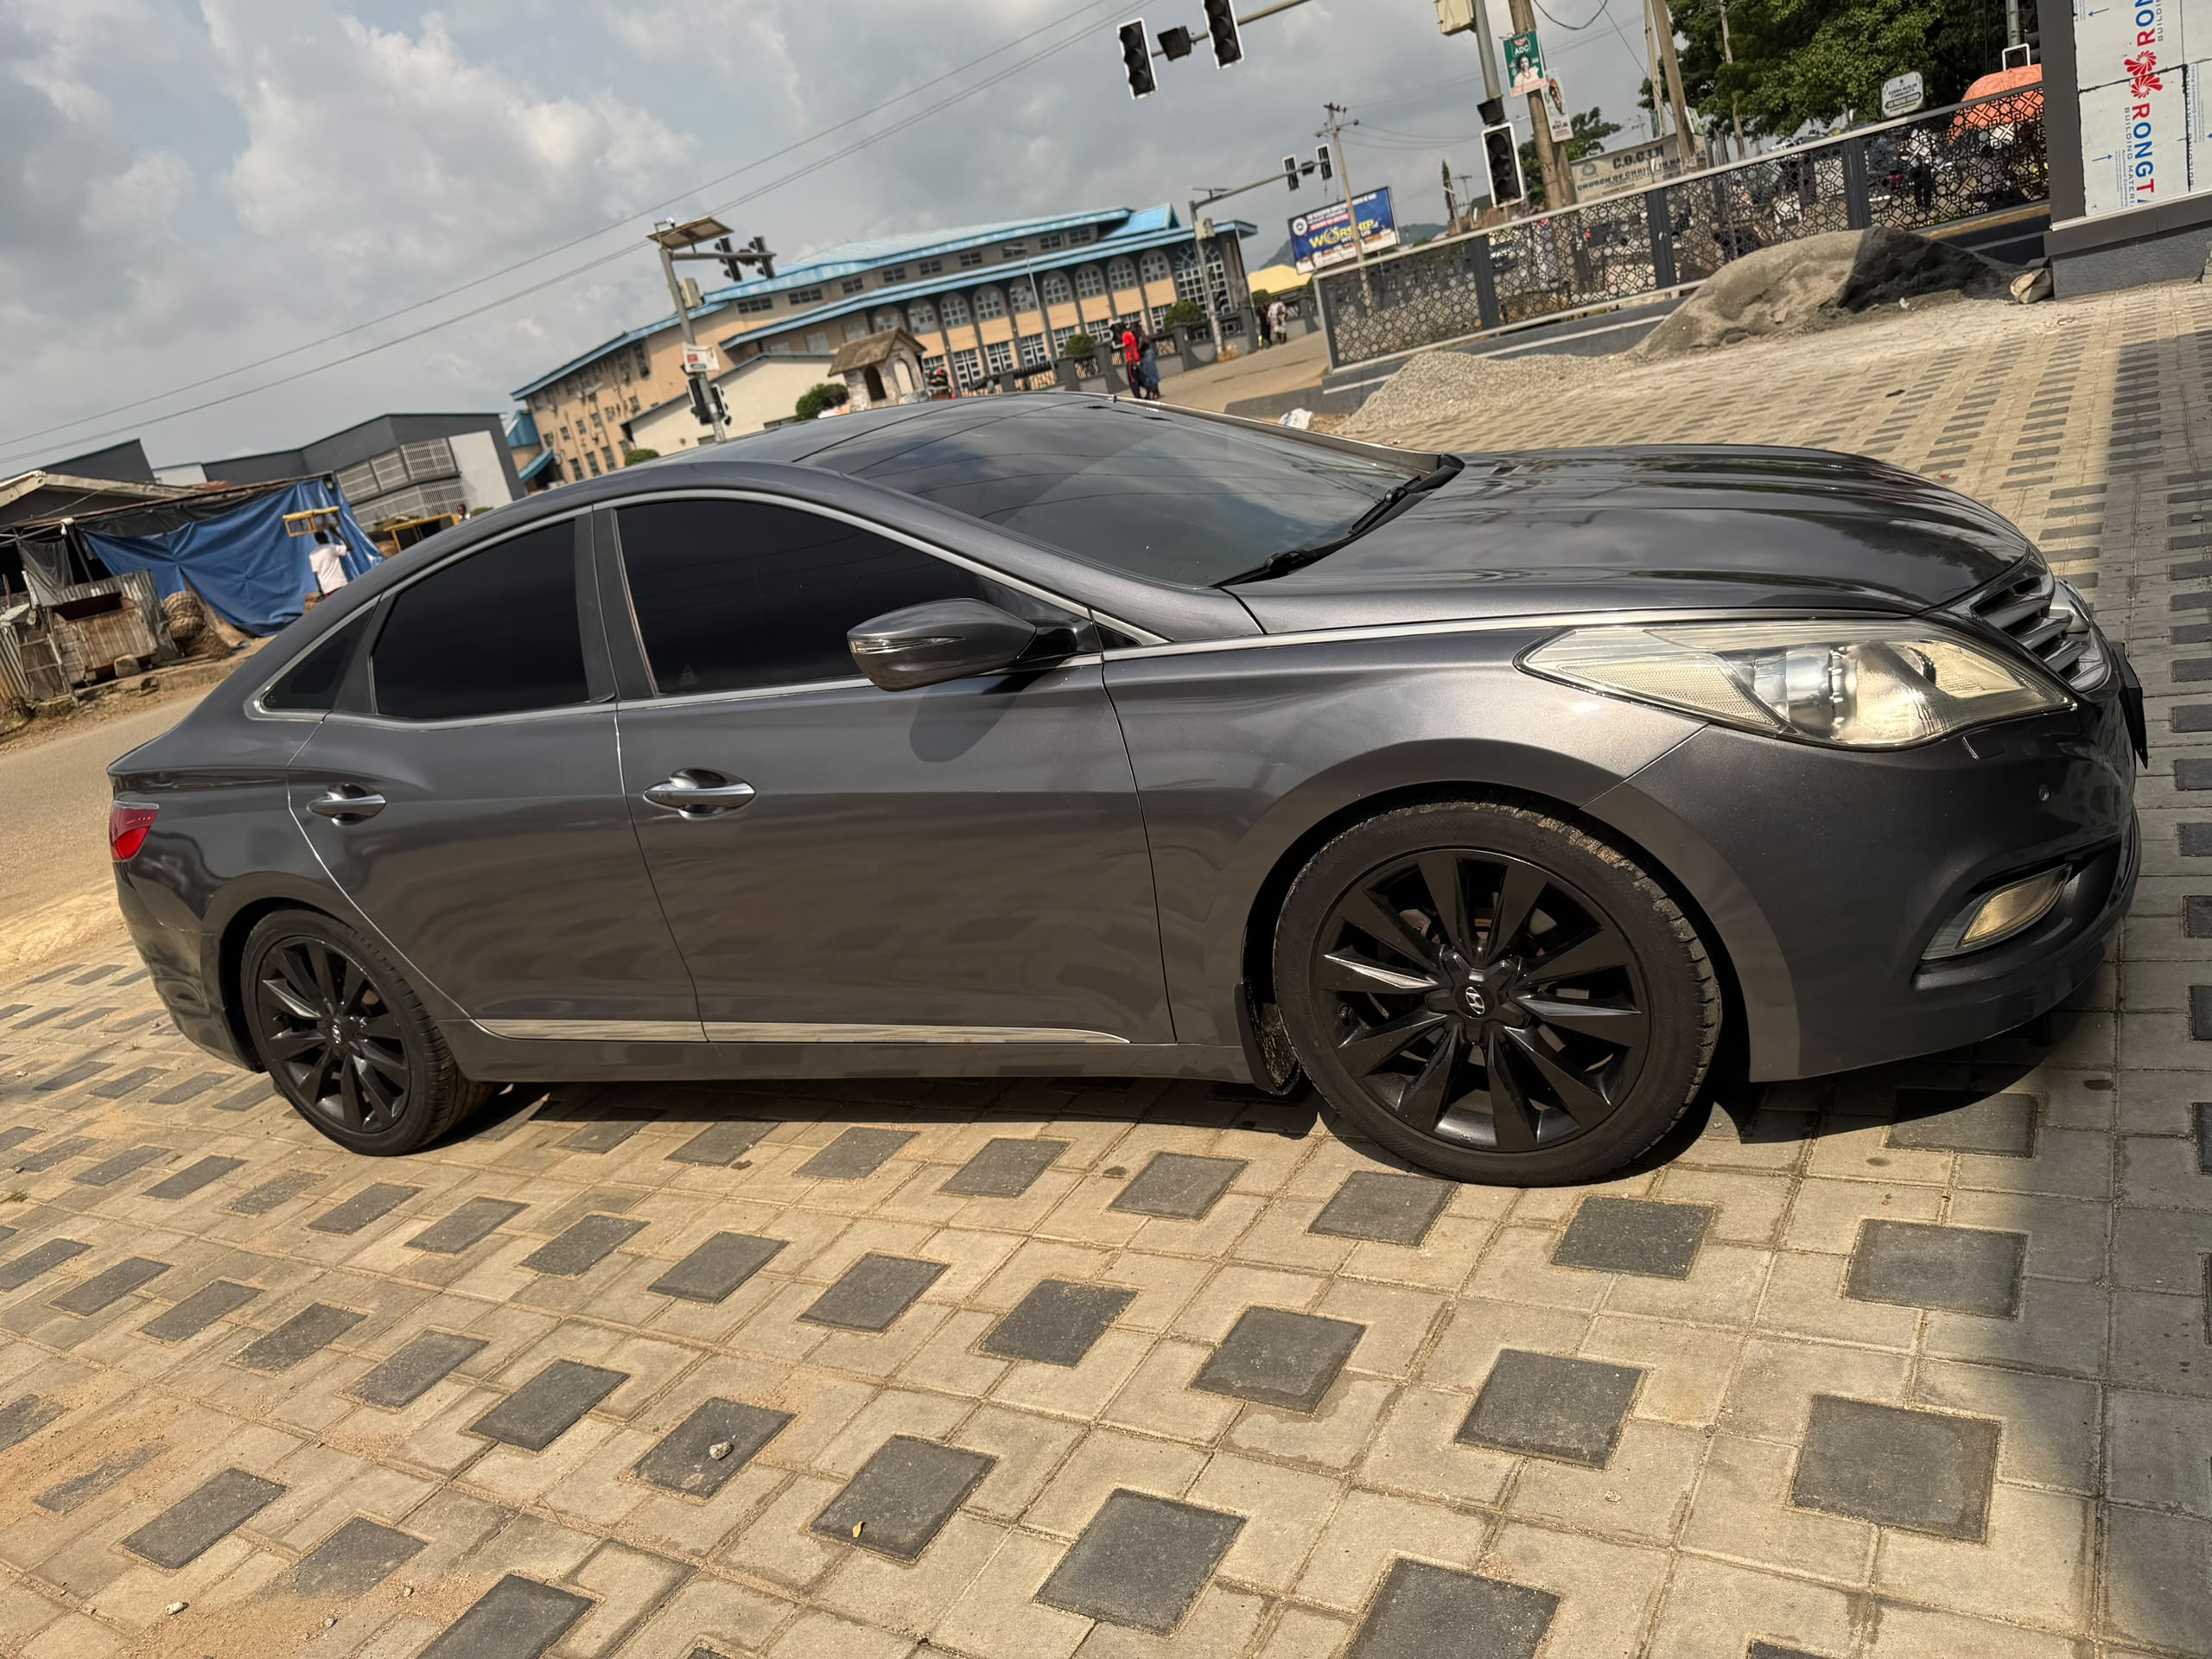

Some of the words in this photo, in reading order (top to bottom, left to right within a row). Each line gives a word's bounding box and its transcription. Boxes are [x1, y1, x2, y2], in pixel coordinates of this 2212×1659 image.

[1514, 45, 1530, 55] ADC
[2124, 107, 2133, 160] BUILDING
[1577, 177, 1611, 191] CHURCH
[1612, 173, 1623, 182] OF
